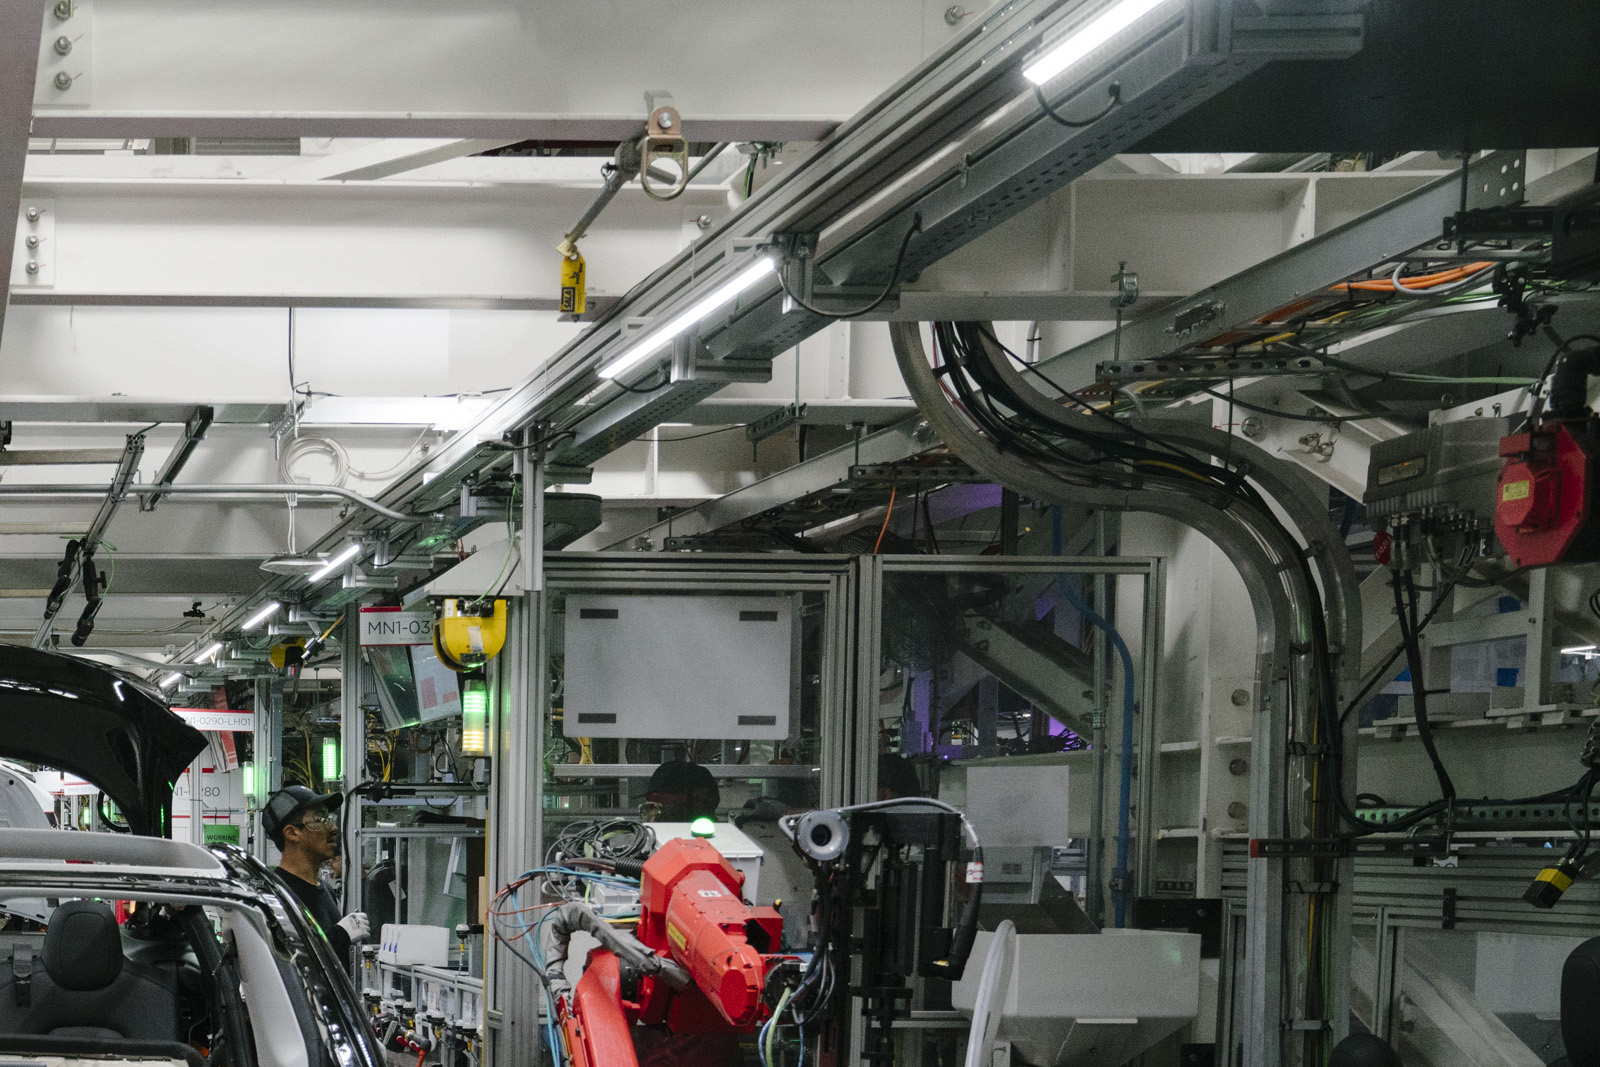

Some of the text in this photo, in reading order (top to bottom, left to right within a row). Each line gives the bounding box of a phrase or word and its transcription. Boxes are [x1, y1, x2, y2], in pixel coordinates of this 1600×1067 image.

[563, 288, 572, 308] SALA
[368, 620, 434, 635] MN1-03
[206, 834, 237, 842] WORKING
